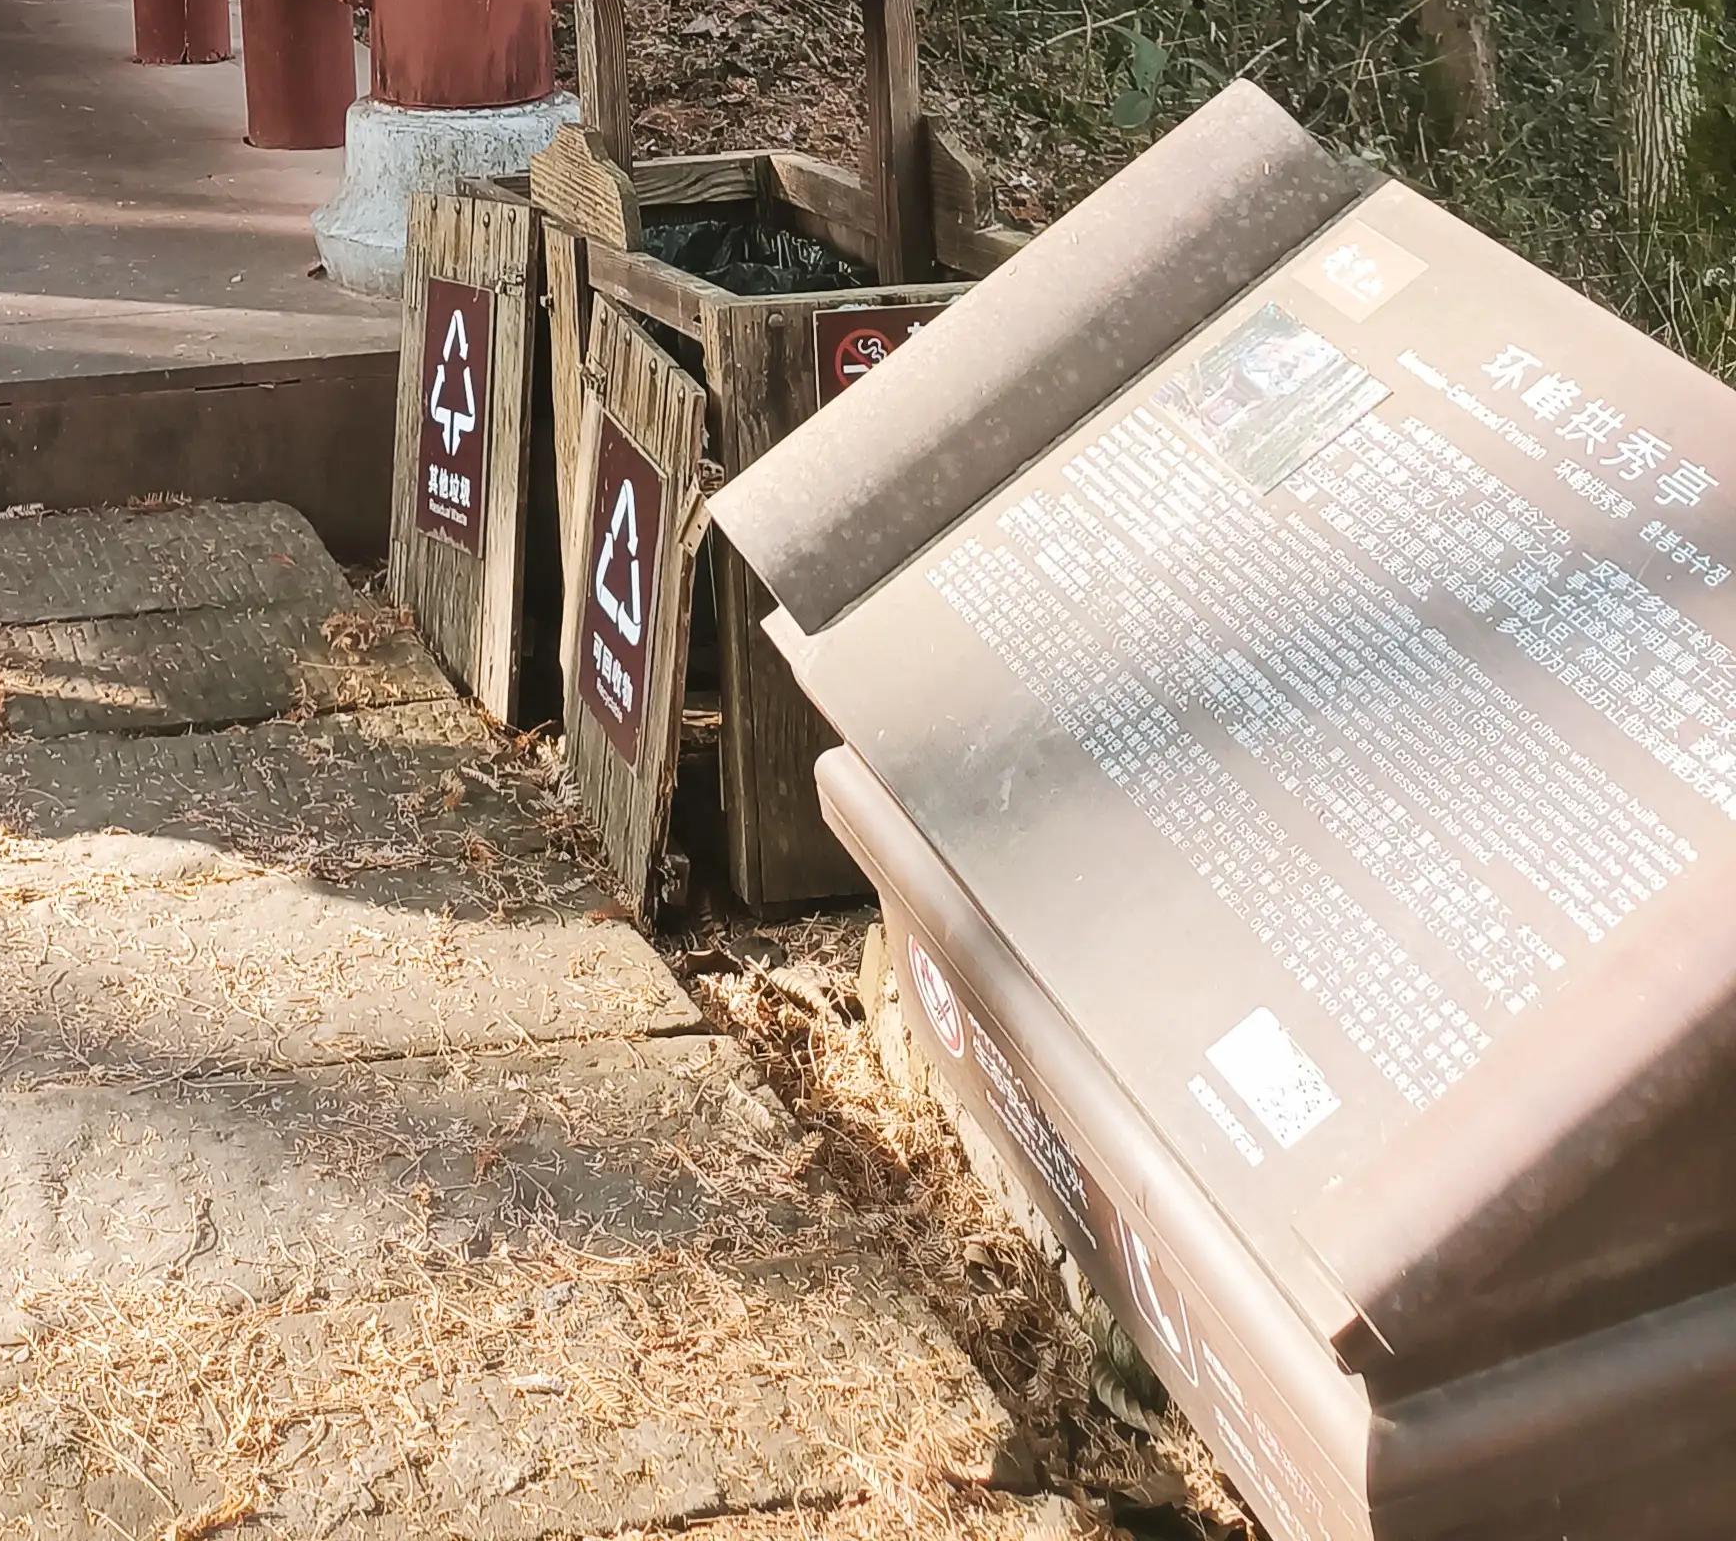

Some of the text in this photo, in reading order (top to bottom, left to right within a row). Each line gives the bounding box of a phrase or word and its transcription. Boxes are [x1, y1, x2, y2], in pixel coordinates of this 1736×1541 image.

[1480, 345, 1720, 505] 环峰拱秀亭
[1498, 420, 1547, 461] Pavilion
[1553, 458, 1636, 518] 环峰拱秀亭
[593, 630, 633, 713] 可回收物
[1211, 602, 1240, 631] which
[1236, 624, 1253, 642] he
[1248, 636, 1274, 659] had
[1267, 653, 1287, 674] the
[1280, 670, 1324, 709] pavilion
[1320, 703, 1349, 730] built
[1342, 726, 1360, 742] as
[1356, 738, 1374, 756] an
[1371, 752, 1432, 809] expression
[1428, 805, 1449, 820] of
[1440, 814, 1462, 836] his
[1458, 833, 1494, 866] mind.
[1224, 593, 1252, 617] After
[1244, 613, 1278, 642] years
[1274, 638, 1293, 652] of
[1284, 648, 1323, 681] official
[1316, 675, 1337, 700] life,
[1335, 693, 1354, 712] he
[1351, 707, 1375, 731] was
[1373, 727, 1401, 752] well
[1394, 749, 1452, 802] conscious
[1449, 798, 1469, 814] of
[1462, 808, 1485, 831] the
[1481, 825, 1550, 892] importance
[1239, 585, 1270, 611] back
[1265, 605, 1279, 620] to
[1275, 614, 1294, 633] his
[1290, 627, 1342, 680] hometown,
[1341, 676, 1367, 697] still
[1359, 692, 1372, 705] a
[1368, 698, 1394, 724] little
[1391, 721, 1434, 757] scared
[1427, 754, 1448, 768] of
[1439, 762, 1462, 785] the
[1458, 781, 1484, 805] ups
[1480, 801, 1510, 826] and
[1503, 822, 1545, 864] downs,
[1241, 561, 1282, 598] Minister
[1277, 595, 1297, 609] of
[1287, 602, 1342, 651] Personnel
[1335, 647, 1365, 672] after
[1357, 669, 1402, 708] praying
[1399, 703, 1468, 765] successfully
[1463, 759, 1485, 779] for
[1480, 776, 1493, 789] a
[1490, 785, 1516, 808] son
[1512, 802, 1535, 824] for
[1530, 818, 1554, 842] the
[1244, 541, 1288, 586] Province.
[1288, 579, 1319, 611] Wang
[1315, 604, 1342, 627] had
[1335, 621, 1365, 651] been
[1361, 646, 1378, 662] so
[1375, 659, 1438, 712] successful
[1432, 707, 1478, 750] through
[1475, 744, 1497, 766] his
[1494, 763, 1541, 802] official
[1535, 799, 1580, 837] career
[1277, 528, 1316, 560] around
[1309, 555, 1341, 584] which
[1337, 580, 1358, 598] are
[1354, 594, 1409, 641] mountains
[1405, 636, 1463, 690] flourishing
[1460, 684, 1486, 708] with
[1480, 705, 1519, 737] green
[1516, 731, 1550, 766] trees,
[1550, 761, 1611, 816] rendering
[1279, 550, 1306, 575] built
[1300, 568, 1319, 583] in
[1310, 575, 1330, 597] the
[1328, 592, 1352, 617] 15th
[1345, 610, 1376, 635] year
[1371, 632, 1391, 646] of
[1383, 640, 1432, 683] Emperor
[1461, 709, 1505, 747] (1536)
[1500, 742, 1527, 768] with
[1524, 762, 1547, 786] the
[1544, 781, 1599, 830] donation
[1285, 511, 1384, 595] Mountain-Embraced
[1378, 589, 1421, 633] Pavilion,
[1421, 628, 1470, 669] different
[1464, 662, 1493, 690] from
[1489, 686, 1523, 714] most
[1518, 710, 1539, 724] of
[1531, 721, 1571, 756] others
[1569, 751, 1607, 786] which
[1603, 782, 1629, 804] are
